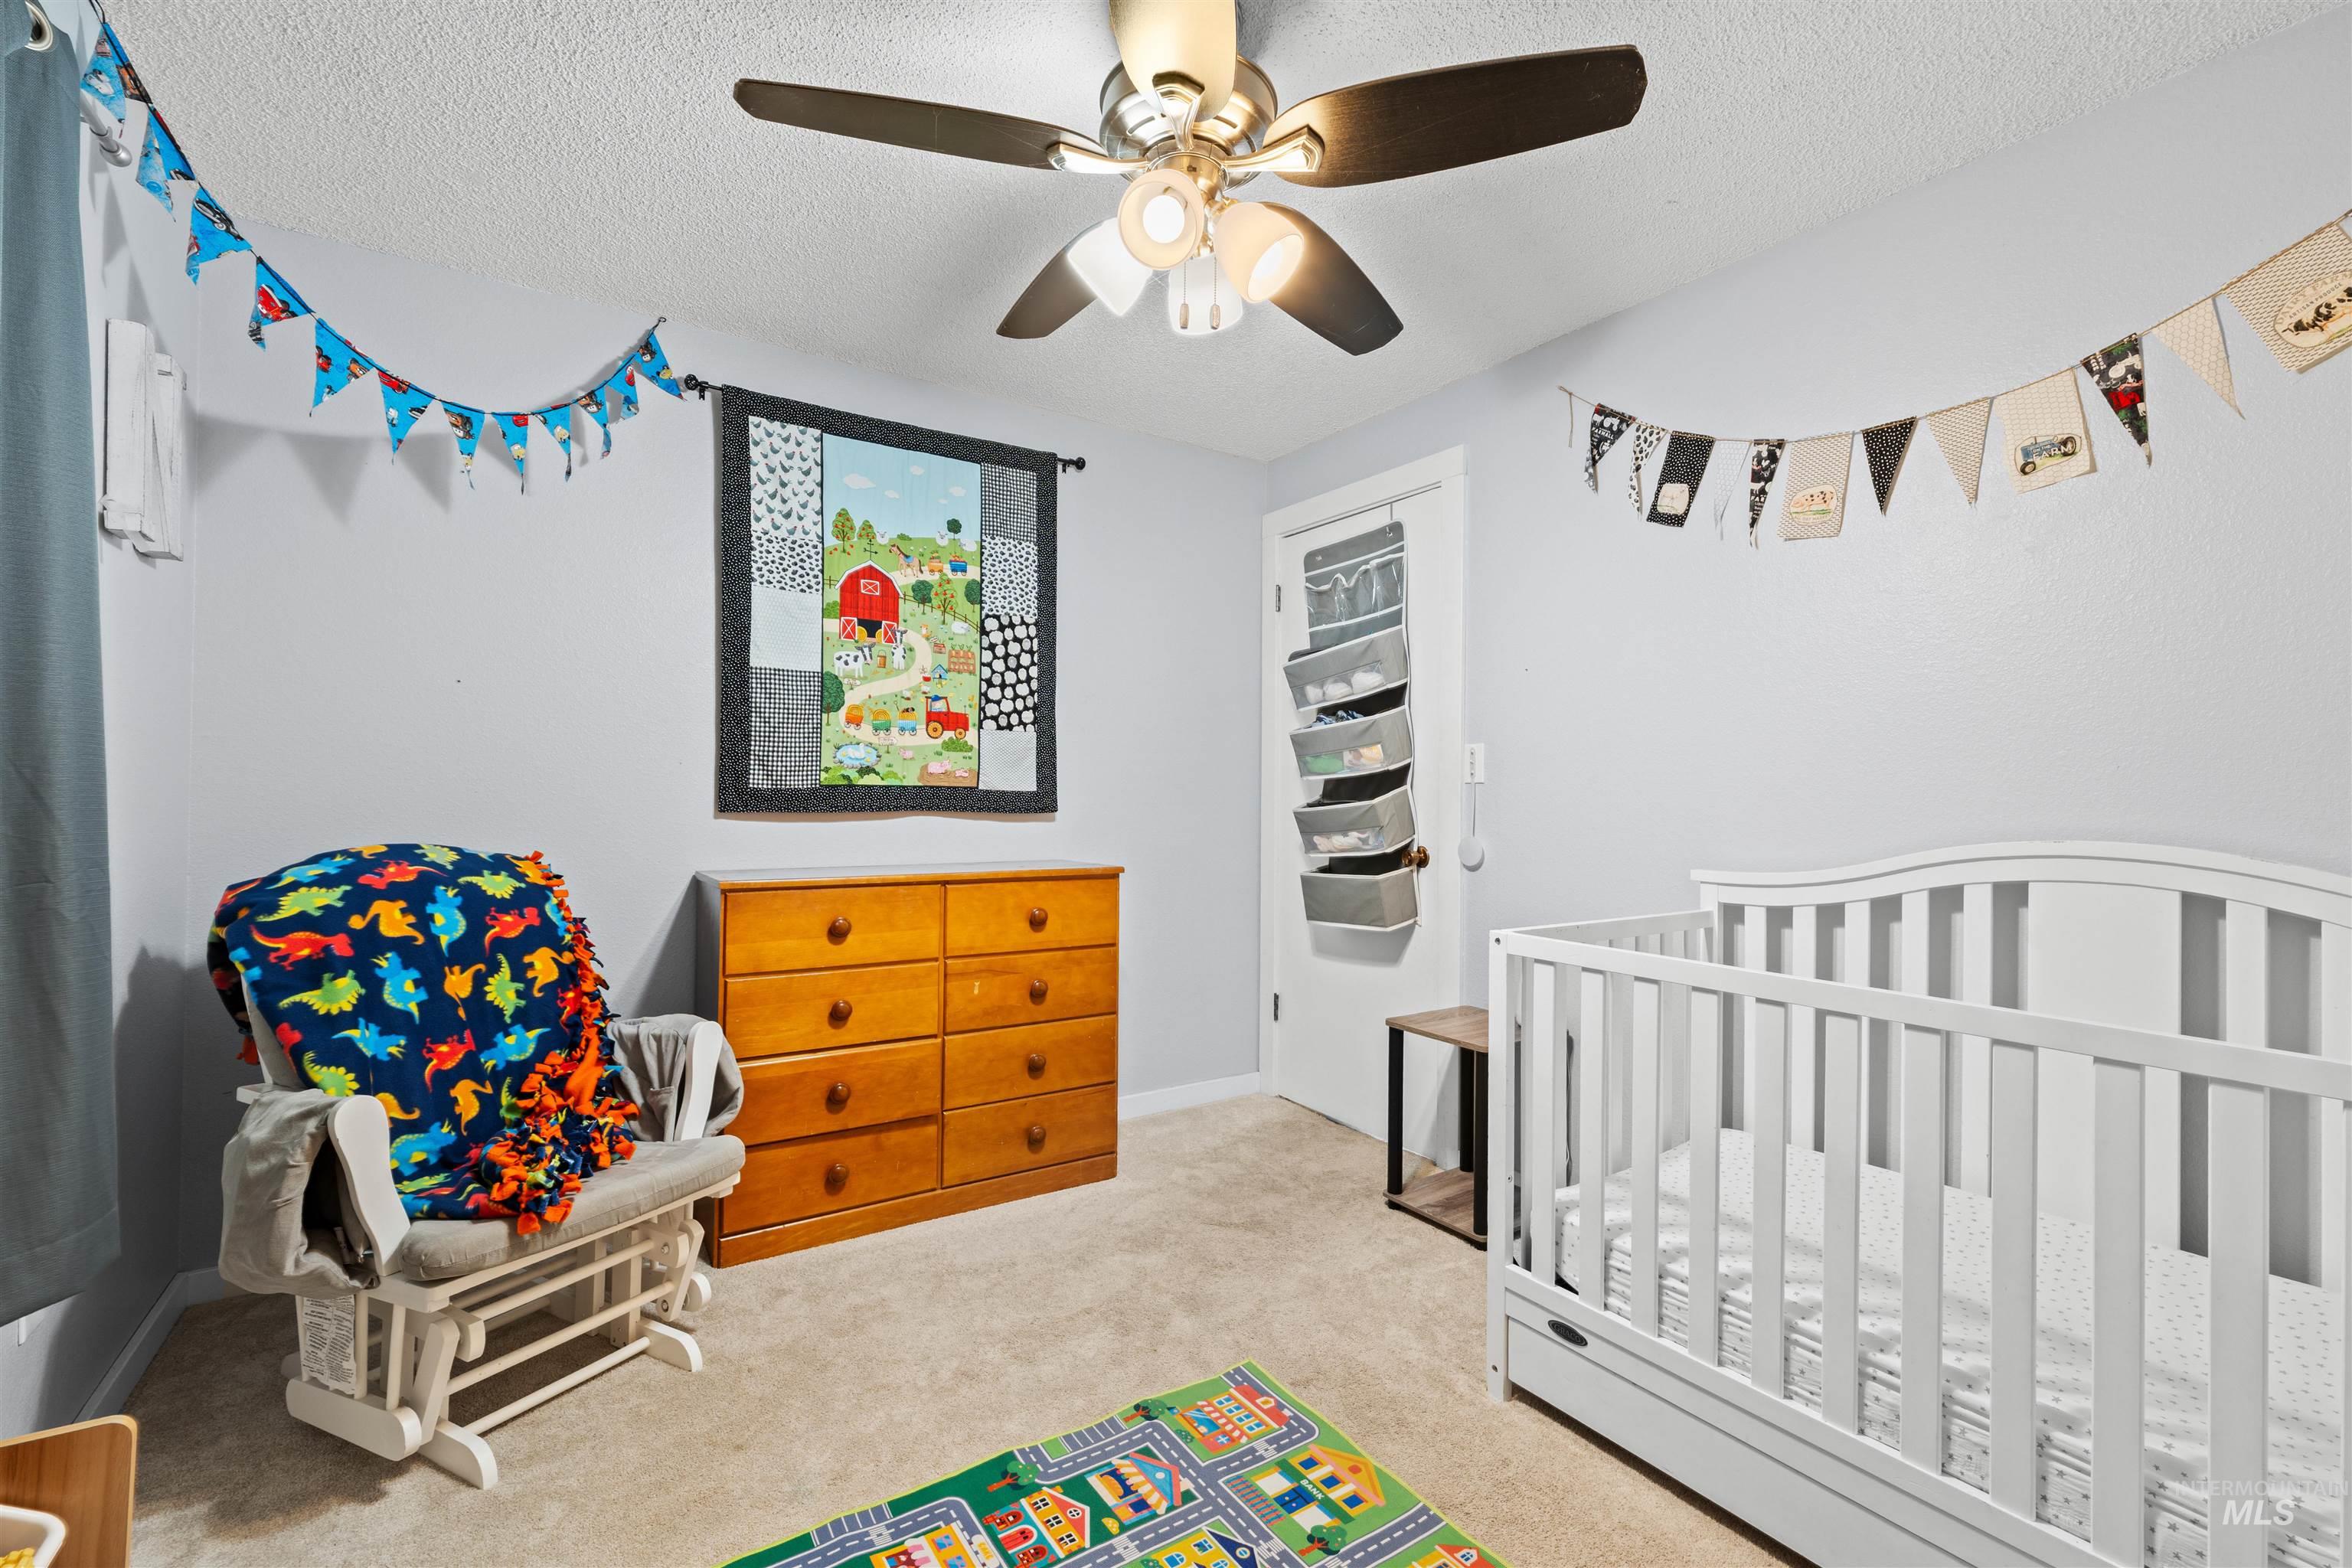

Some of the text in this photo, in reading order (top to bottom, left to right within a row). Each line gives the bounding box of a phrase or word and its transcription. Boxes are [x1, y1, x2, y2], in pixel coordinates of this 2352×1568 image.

[2289, 283, 2342, 319] ARTISAN PRODUCE
[1592, 427, 1614, 439] FARMALL
[2033, 445, 2073, 461] FARM
[1554, 1325, 1581, 1343] GRACO
[1299, 1478, 1325, 1500] BANK
